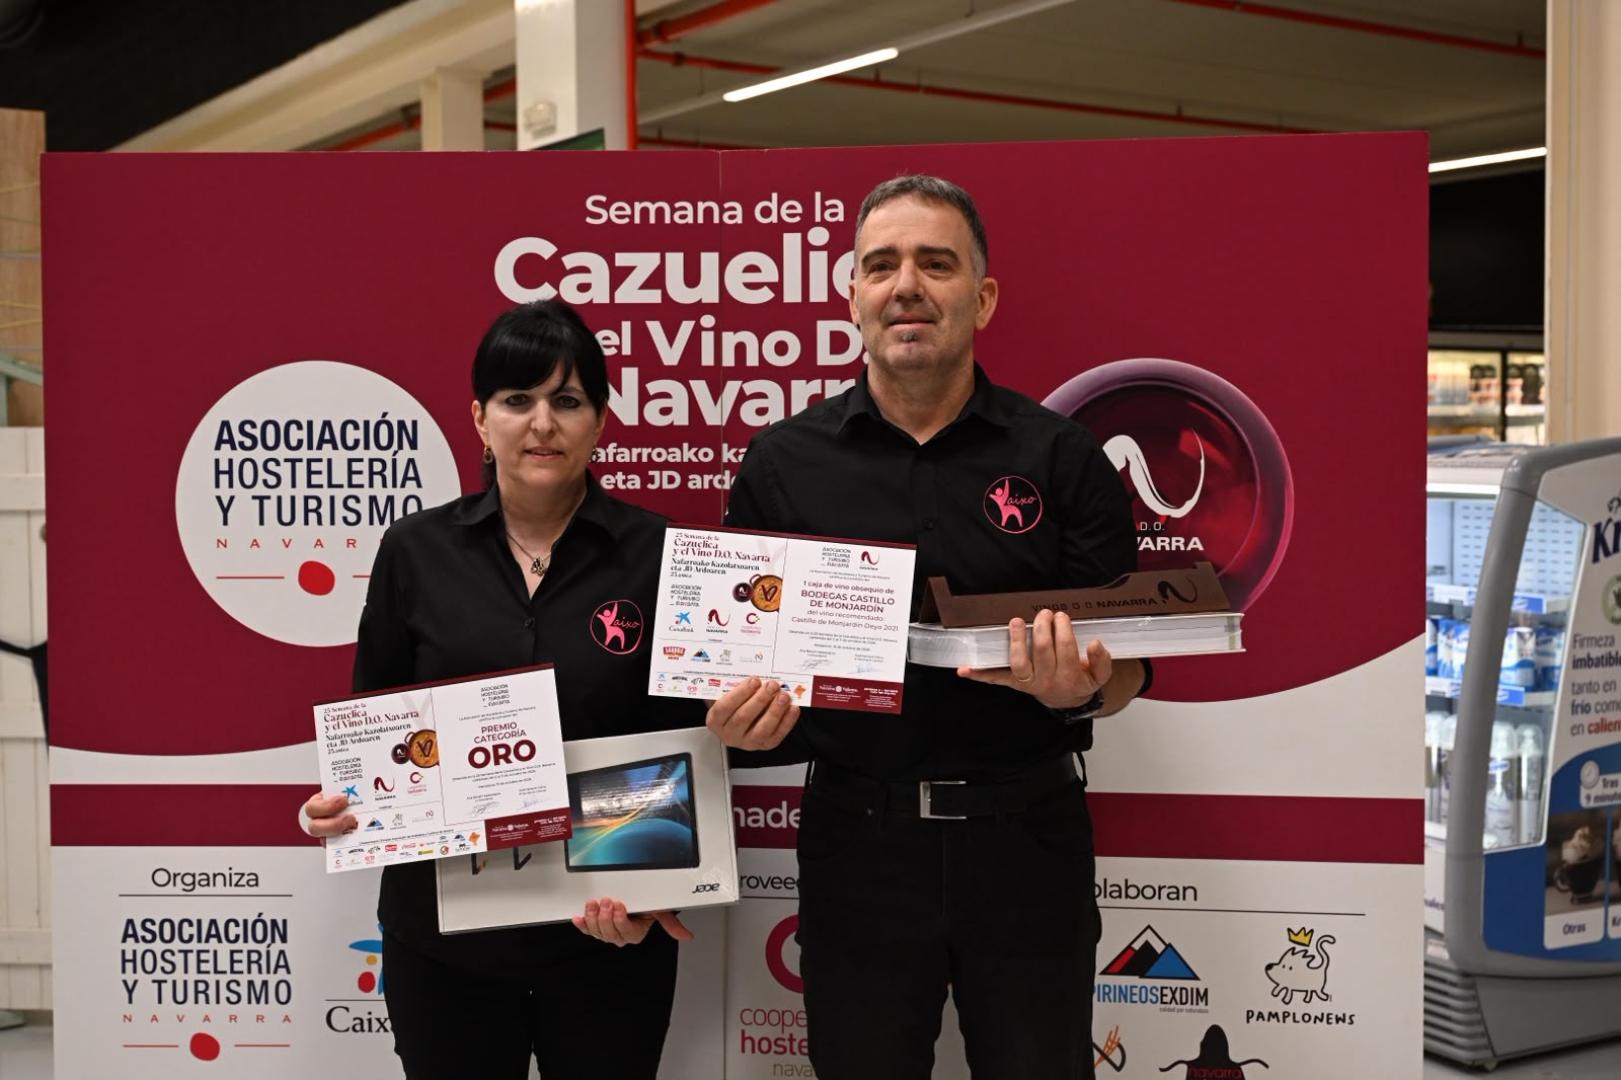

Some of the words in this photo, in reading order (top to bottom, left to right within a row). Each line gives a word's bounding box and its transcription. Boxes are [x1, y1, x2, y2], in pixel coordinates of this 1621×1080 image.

[585, 194, 743, 224] Semana
[754, 192, 803, 223] de
[814, 191, 844, 222] la
[645, 314, 802, 367] Vino
[214, 412, 418, 452] ASOCIACIÓN
[214, 450, 423, 489] HOSTELERÍA
[600, 471, 641, 490] eta
[647, 470, 682, 490] JD
[215, 495, 235, 526] Y
[251, 494, 423, 526] TURISMO
[216, 538, 384, 549] NAVAR
[691, 548, 712, 557] Vino
[735, 551, 770, 562] Navarra
[801, 589, 848, 601] BODEGAS
[850, 594, 896, 605] CASTILLO
[851, 585, 884, 594] obsequio
[810, 599, 824, 608] DE
[1096, 598, 1158, 609] NAVARRA
[791, 616, 817, 624] Castillo
[1573, 633, 1615, 649] Firmeza
[1571, 681, 1600, 696] tanto
[1602, 679, 1617, 693] en
[343, 719, 363, 729] Vino
[384, 710, 420, 722] Navarra
[481, 721, 517, 734] PREMIO
[474, 729, 527, 744] CATEGORÍA
[1570, 723, 1585, 737] en
[468, 739, 536, 769] ORO
[1602, 777, 1618, 789] Tras
[151, 867, 260, 892] Organiza
[740, 874, 800, 890] rovee
[692, 882, 720, 894] acer
[121, 912, 288, 944] ASOCIACIÓN
[1562, 923, 1586, 935] Otras
[121, 943, 292, 975] HOSTELERÍA
[122, 979, 138, 1005] Y
[152, 979, 292, 1005] TURISMO
[123, 1014, 291, 1023] NAVARRA
[1246, 1009, 1356, 1026] PAMPLONEWS
